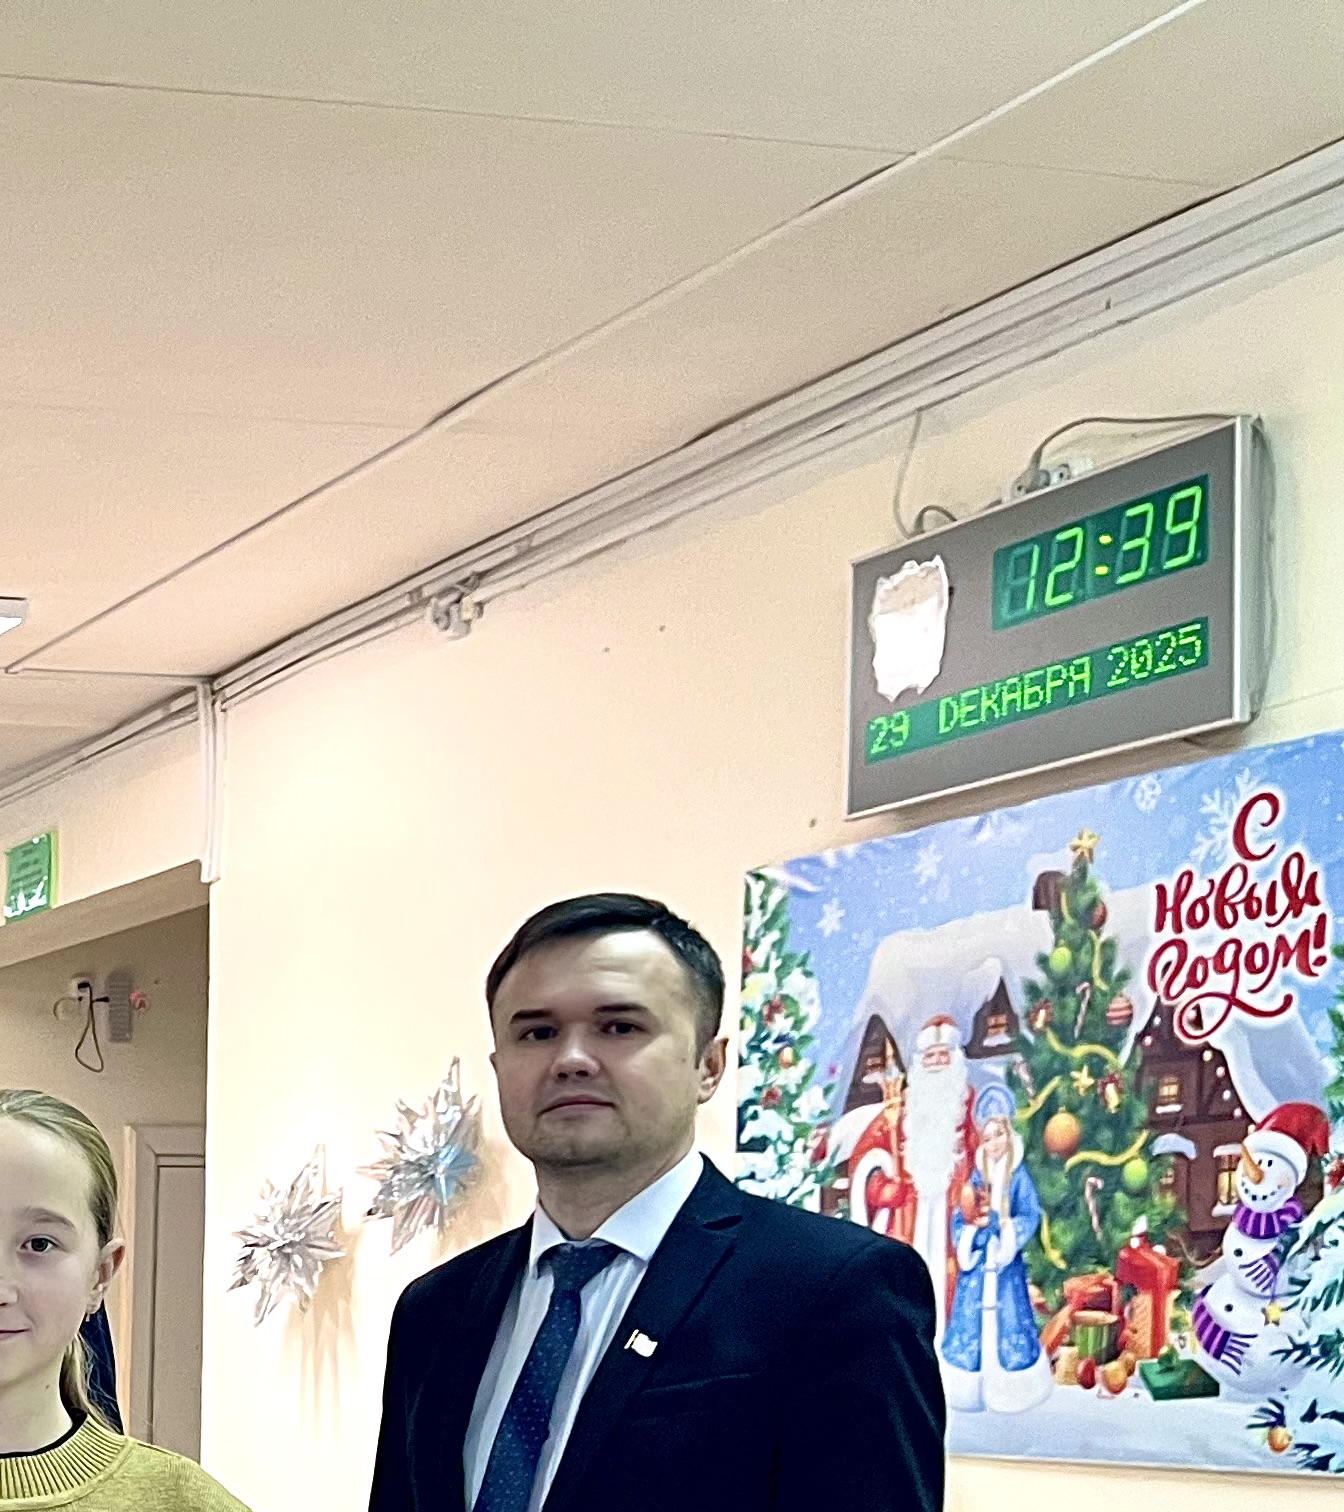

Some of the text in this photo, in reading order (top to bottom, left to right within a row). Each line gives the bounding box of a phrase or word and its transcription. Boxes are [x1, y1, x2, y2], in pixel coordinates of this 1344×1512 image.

[1026, 485, 1203, 611] 12:39
[869, 710, 910, 755] 29
[1107, 623, 1203, 687] 2025
[1232, 791, 1281, 862] С
[1154, 851, 1322, 935] Новым
[1147, 912, 1328, 1041] Годом!
